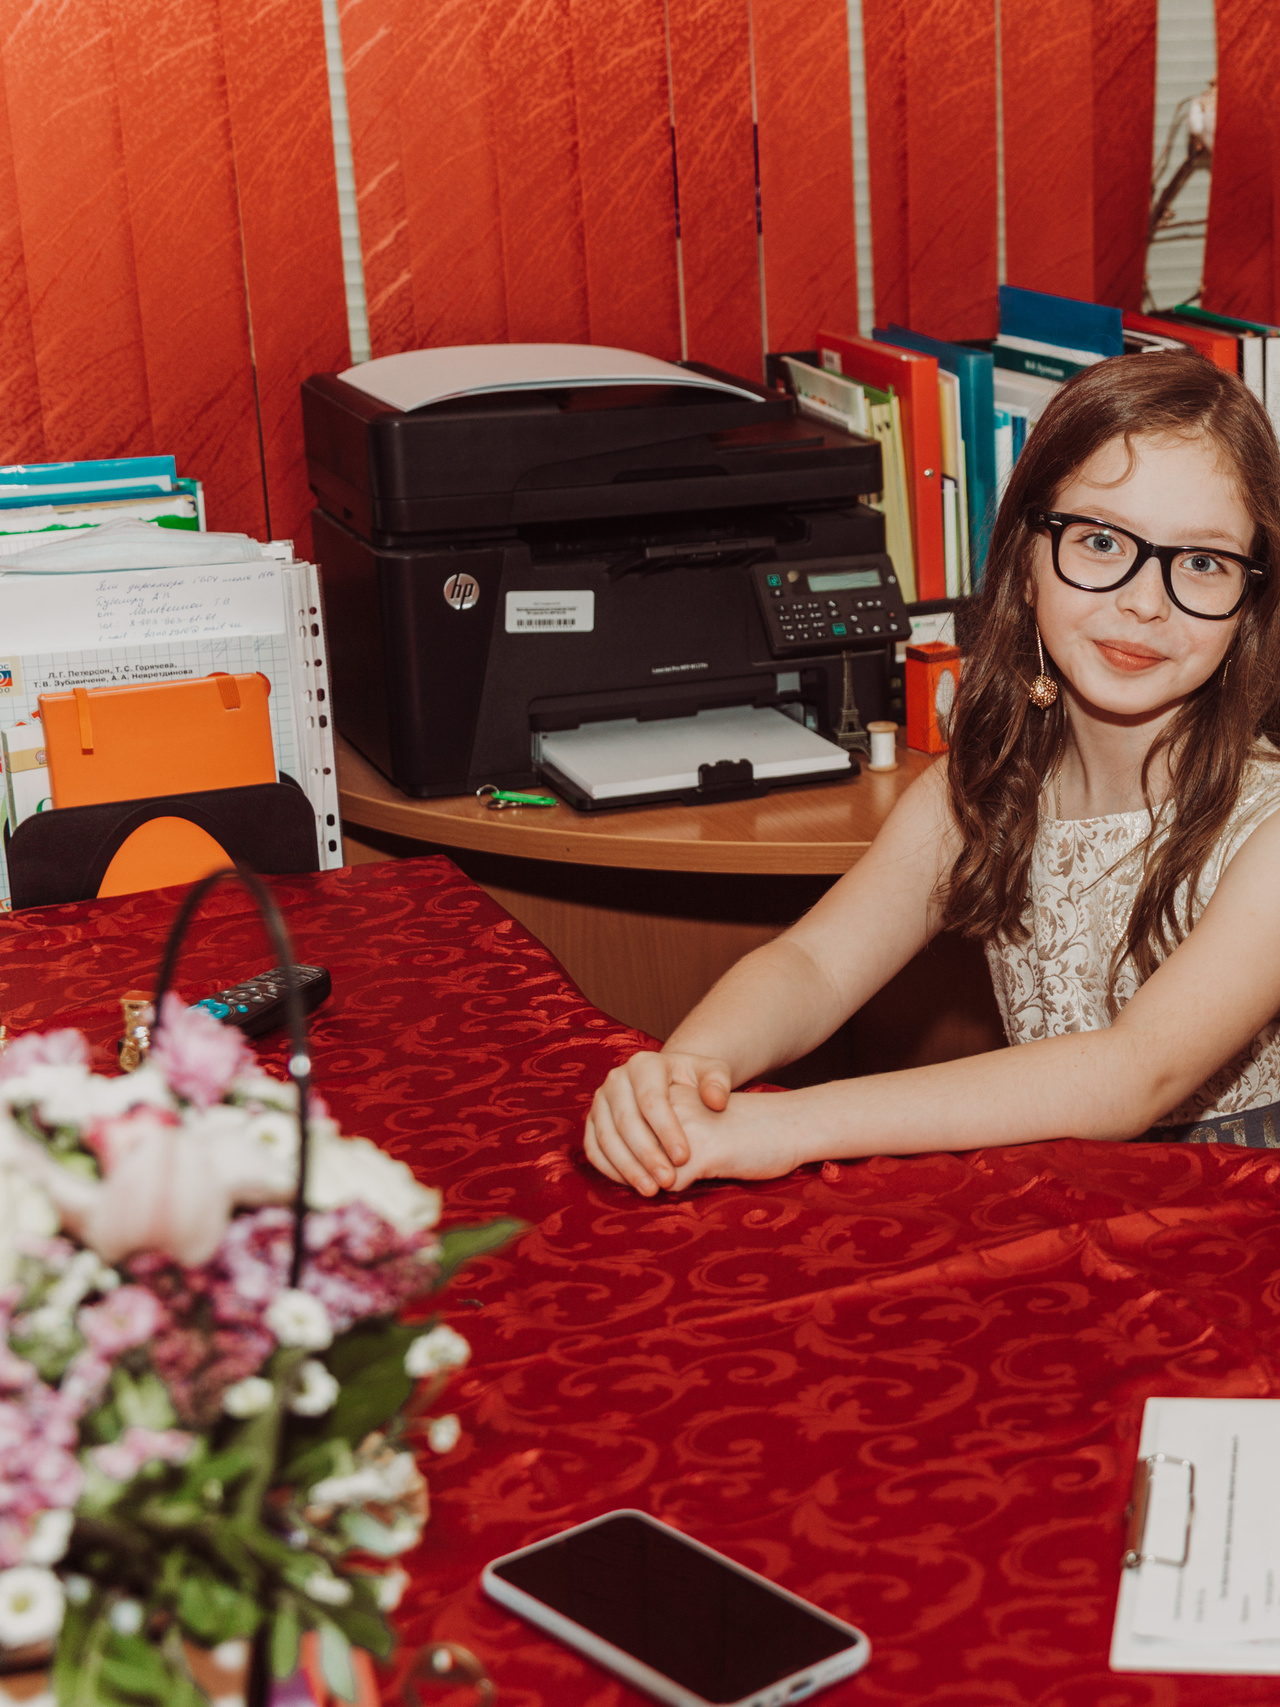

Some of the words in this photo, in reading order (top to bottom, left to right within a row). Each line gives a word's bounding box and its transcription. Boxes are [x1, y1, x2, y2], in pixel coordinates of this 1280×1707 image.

[451, 574, 475, 609] hp
[54, 676, 109, 688] Зубавичене,
[132, 669, 194, 680] Невретдинова
[68, 667, 113, 679] Петерсон,
[135, 662, 178, 673] Горячева,
